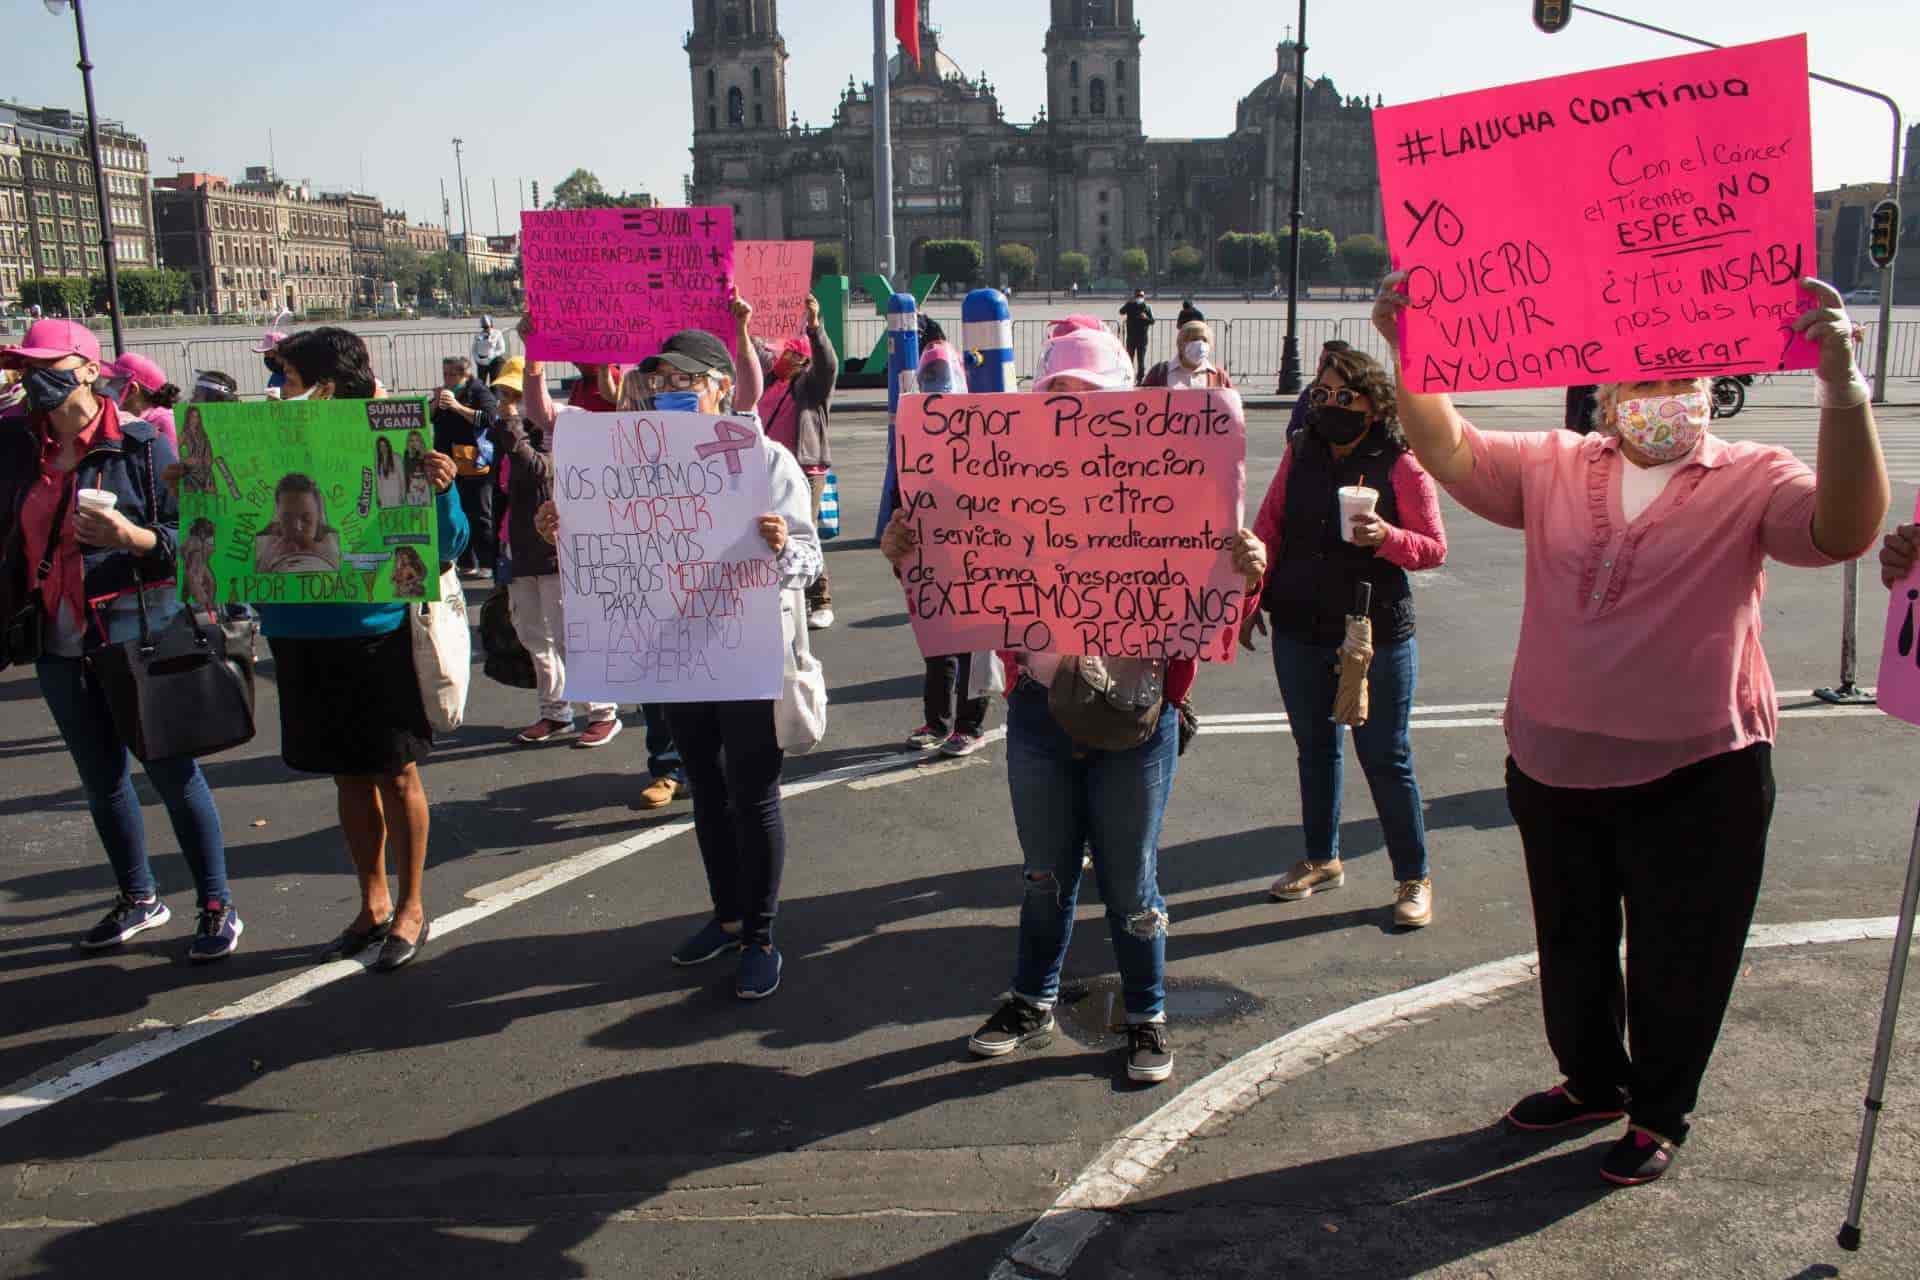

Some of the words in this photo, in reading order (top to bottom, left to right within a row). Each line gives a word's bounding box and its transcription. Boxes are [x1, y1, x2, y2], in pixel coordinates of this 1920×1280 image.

[1396, 110, 1556, 166] #LALUCHA
[1608, 143, 1671, 186] Con
[1680, 135, 1708, 172] el
[1583, 200, 1605, 223] el
[1717, 171, 1771, 201] NO
[1403, 199, 1465, 249] YO
[1616, 202, 1737, 248] ESPERA
[1406, 239, 1552, 319] QUIERO
[1700, 242, 1803, 296] INSABI
[1439, 295, 1555, 349] VIVIR
[1614, 304, 1672, 337] nos
[1633, 336, 1751, 367] Esperar
[367, 401, 423, 416] SÚMATE
[369, 415, 381, 430] Y
[383, 416, 421, 429] GANA
[921, 393, 1021, 440] Señor
[1043, 392, 1231, 438] Presidente
[899, 434, 935, 475] Le
[945, 435, 1069, 479] Pedimos
[1080, 443, 1206, 479] atencion
[601, 459, 724, 500] QUEREMOS
[607, 495, 713, 534] MORIR
[903, 489, 938, 522] ya
[955, 493, 1001, 521] que
[1011, 496, 1067, 516] nos
[1084, 480, 1175, 515] retiro
[555, 531, 705, 567] NECESITAMOS
[933, 524, 1013, 547] servicio
[1023, 534, 1035, 558] y
[1045, 518, 1080, 550] los
[1087, 519, 1234, 551] medicamentos
[560, 563, 665, 598] NUESTROS
[665, 559, 781, 593] MEDICAMENTOS
[906, 546, 936, 584] de
[963, 550, 1038, 583] forma
[1054, 557, 1190, 593] inesperada
[599, 591, 657, 622] PARA
[669, 589, 745, 619] VIVIR
[1114, 586, 1174, 622] QUE
[1184, 585, 1242, 625] NOS
[705, 614, 744, 650] NO
[1003, 616, 1051, 652] LO
[604, 649, 720, 684] ESPERA
